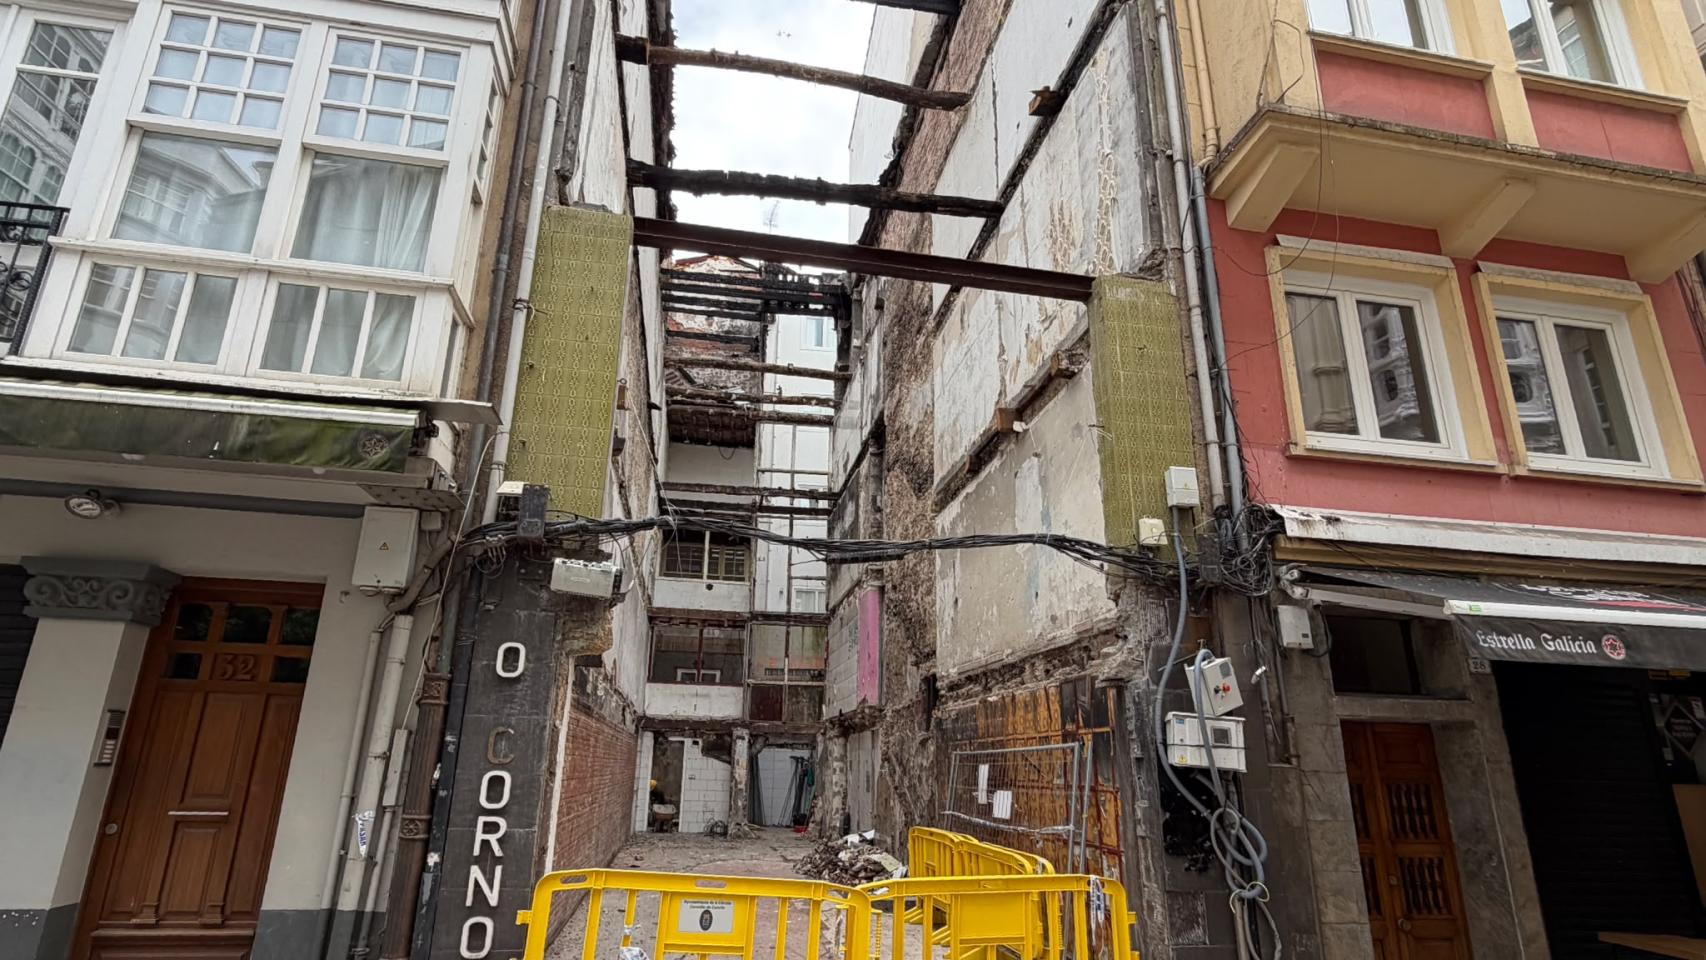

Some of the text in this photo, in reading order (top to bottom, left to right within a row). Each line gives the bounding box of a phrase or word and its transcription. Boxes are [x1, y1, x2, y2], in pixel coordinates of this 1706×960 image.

[1476, 629, 1597, 653] Estrella Galicia
[217, 653, 257, 681] 32
[459, 642, 526, 960] O CORNO
